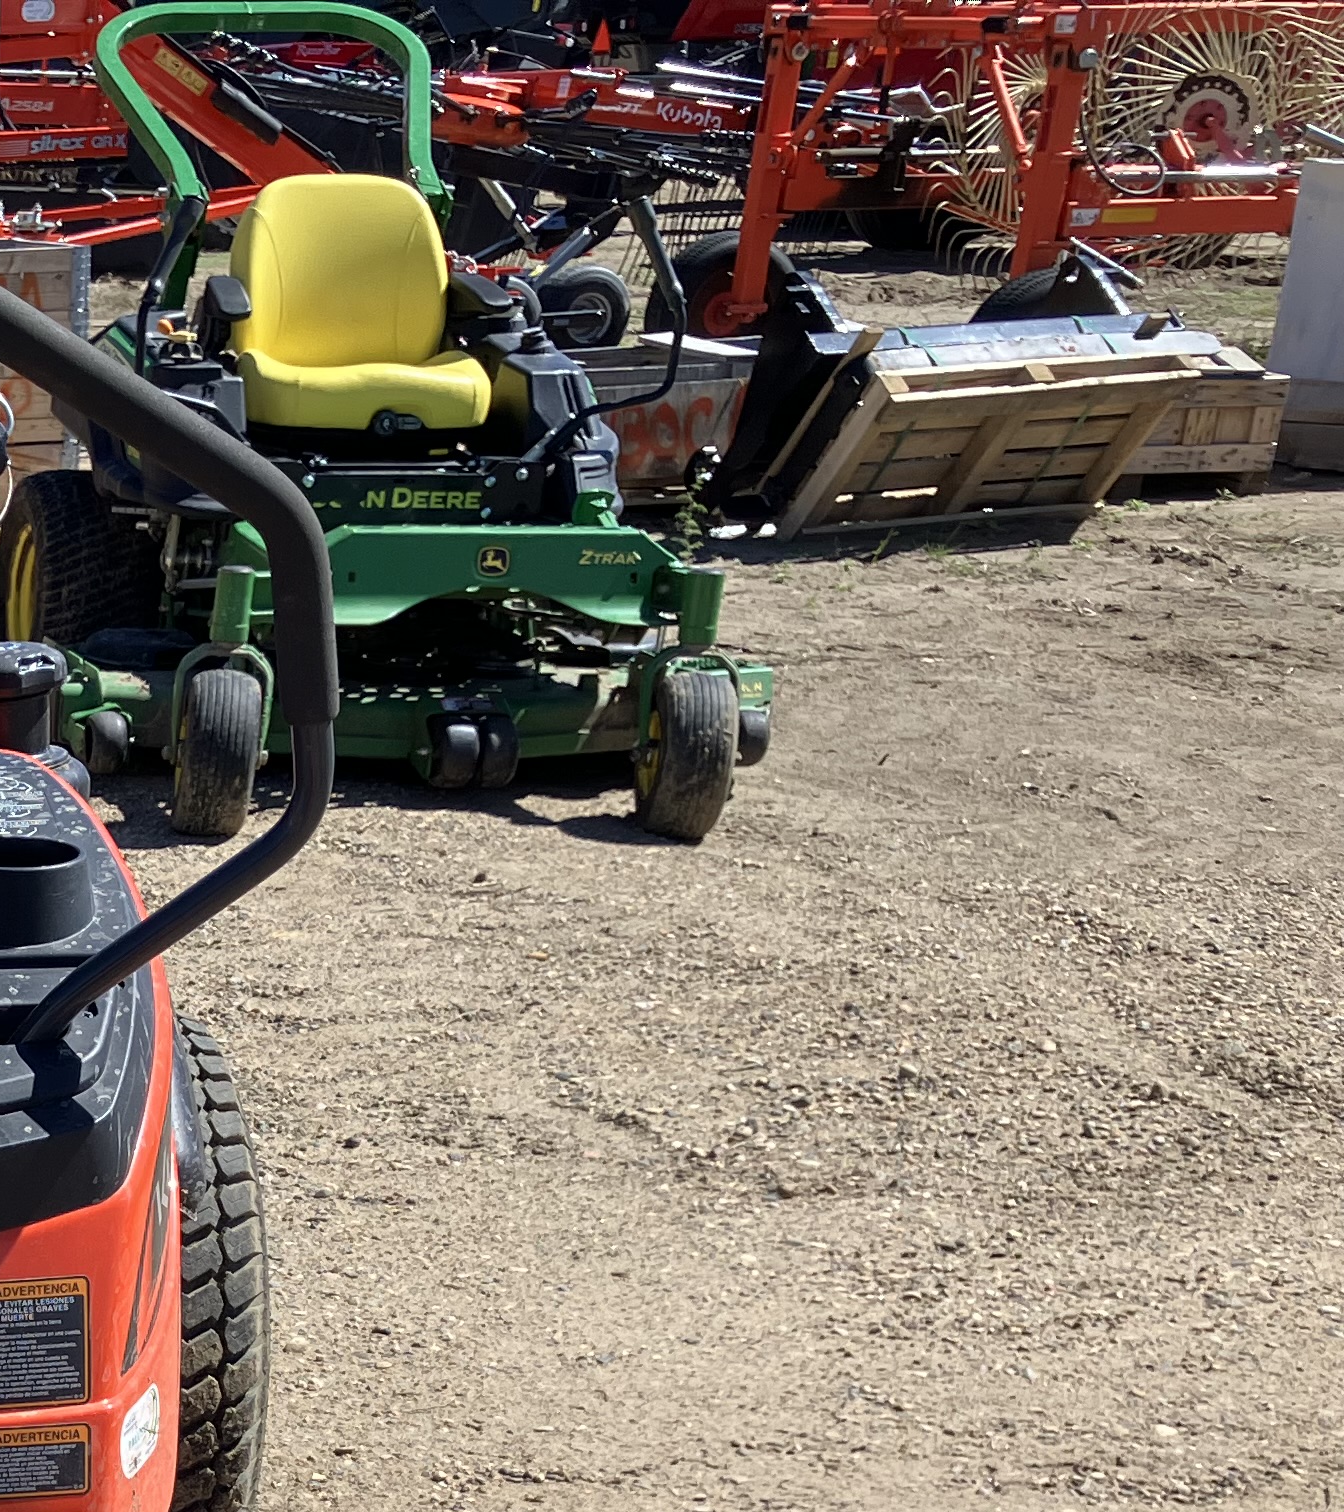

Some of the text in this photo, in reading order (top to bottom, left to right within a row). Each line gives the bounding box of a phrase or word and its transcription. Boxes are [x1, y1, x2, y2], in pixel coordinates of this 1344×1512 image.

[656, 102, 723, 131] Kubota
[29, 134, 89, 155] sitrex
[391, 488, 482, 511] DEERE
[4, 1299, 34, 1307] EVITAR
[35, 1297, 74, 1306] LESIONES
[36, 1304, 69, 1313] GRAVES
[0, 1314, 34, 1322] MUERTE
